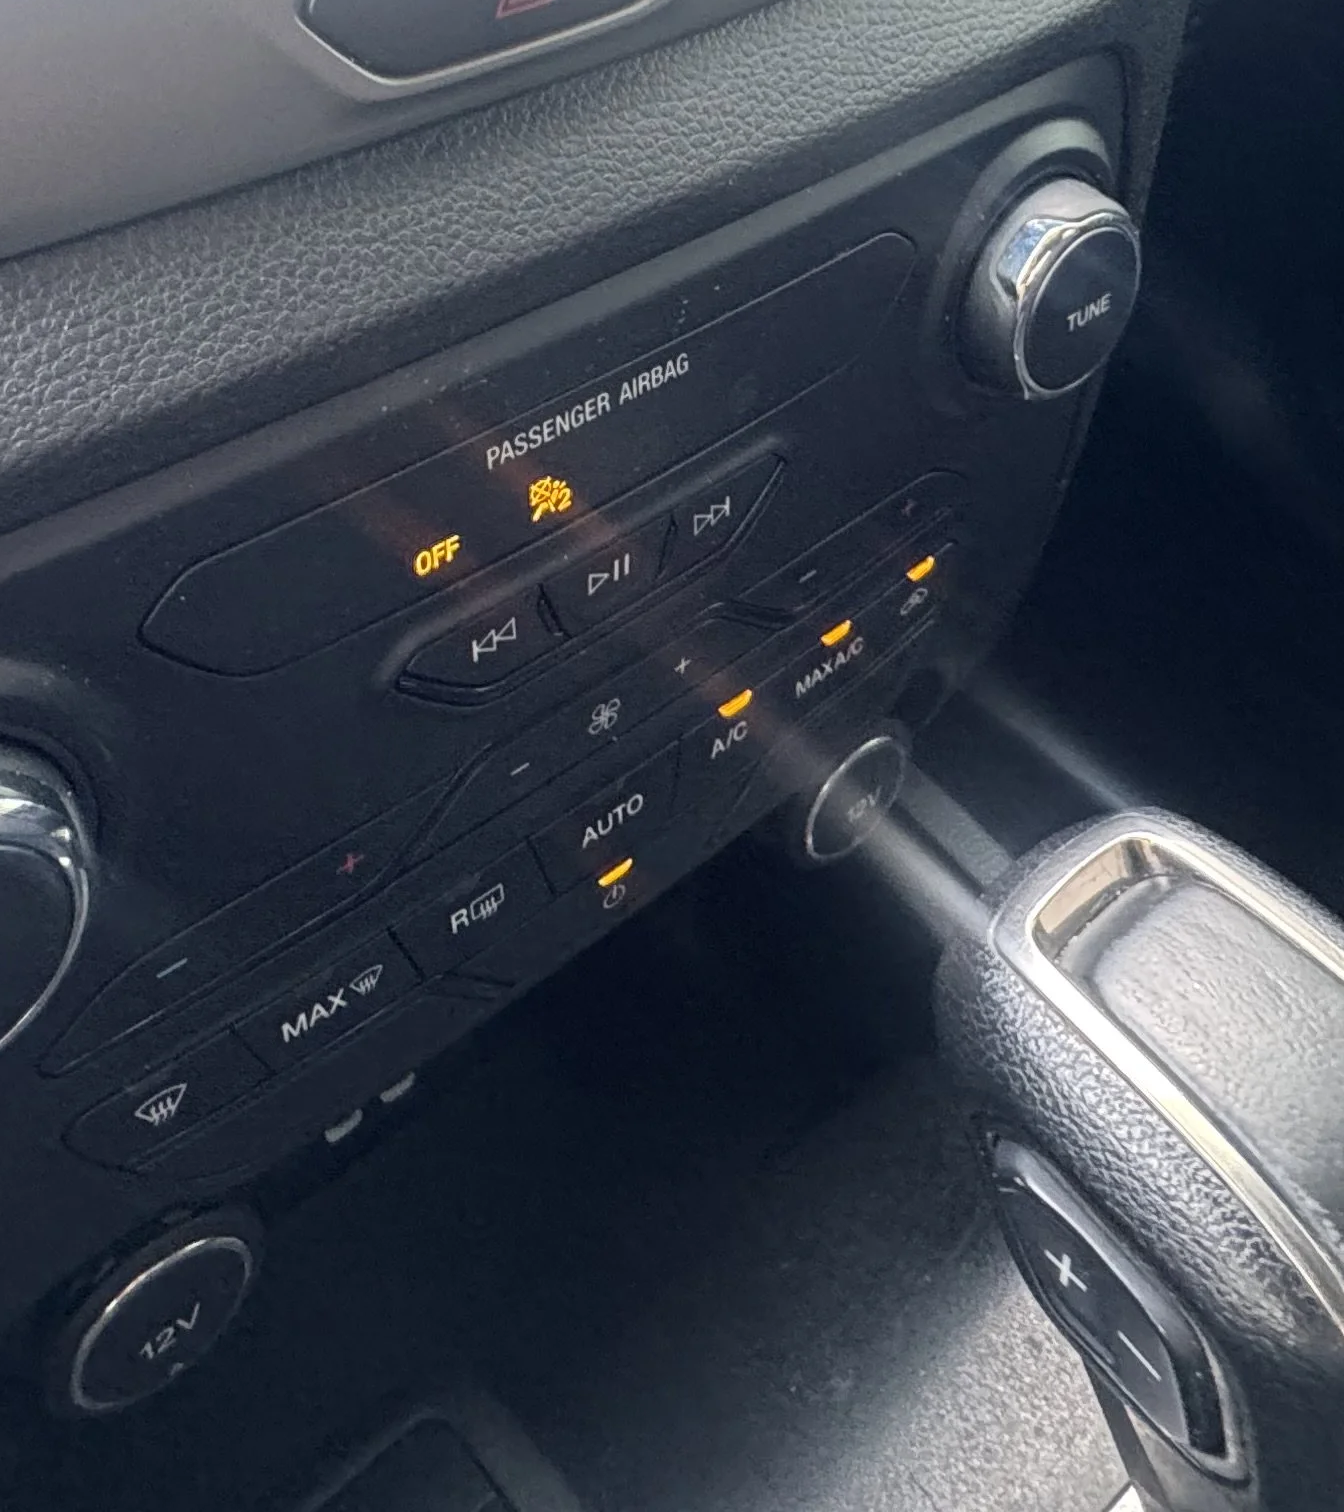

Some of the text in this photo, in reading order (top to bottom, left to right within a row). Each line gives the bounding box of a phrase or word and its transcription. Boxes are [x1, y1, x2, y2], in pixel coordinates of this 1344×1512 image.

[1066, 292, 1113, 333] TUNE
[486, 352, 691, 471] PASSENGER AIRBAG
[413, 534, 462, 577] OFF
[795, 635, 865, 700] MAX A/C
[710, 720, 748, 760] A/C
[581, 793, 645, 849] AUTO
[280, 988, 348, 1043] MAX
[139, 1302, 201, 1361] 12V
